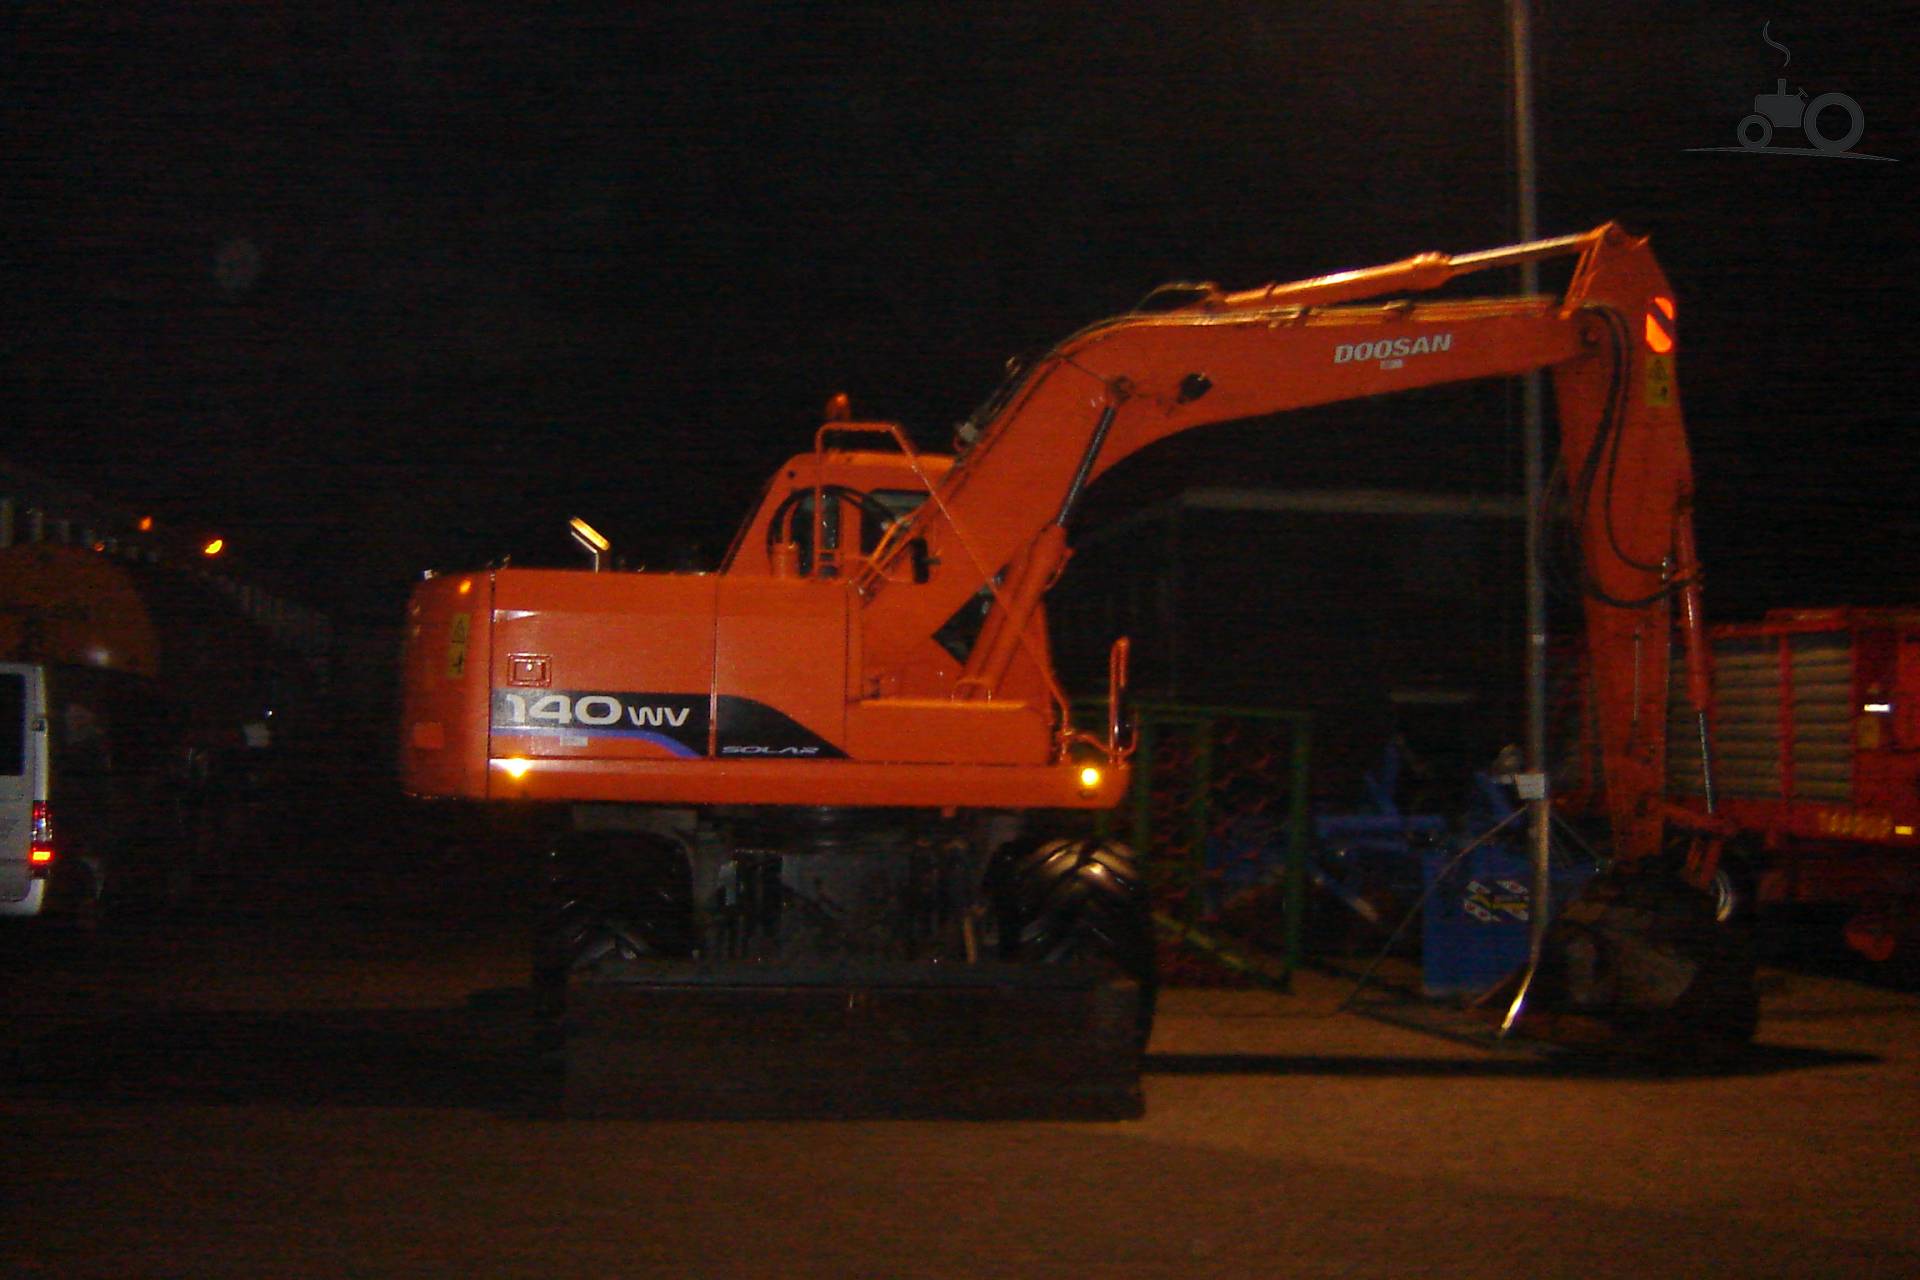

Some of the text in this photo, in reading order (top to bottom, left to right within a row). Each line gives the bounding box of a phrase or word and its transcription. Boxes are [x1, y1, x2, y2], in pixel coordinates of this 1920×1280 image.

[1333, 333, 1453, 363] DOOSAN
[506, 695, 690, 728] 140 WV
[722, 745, 819, 756] SOLAR
